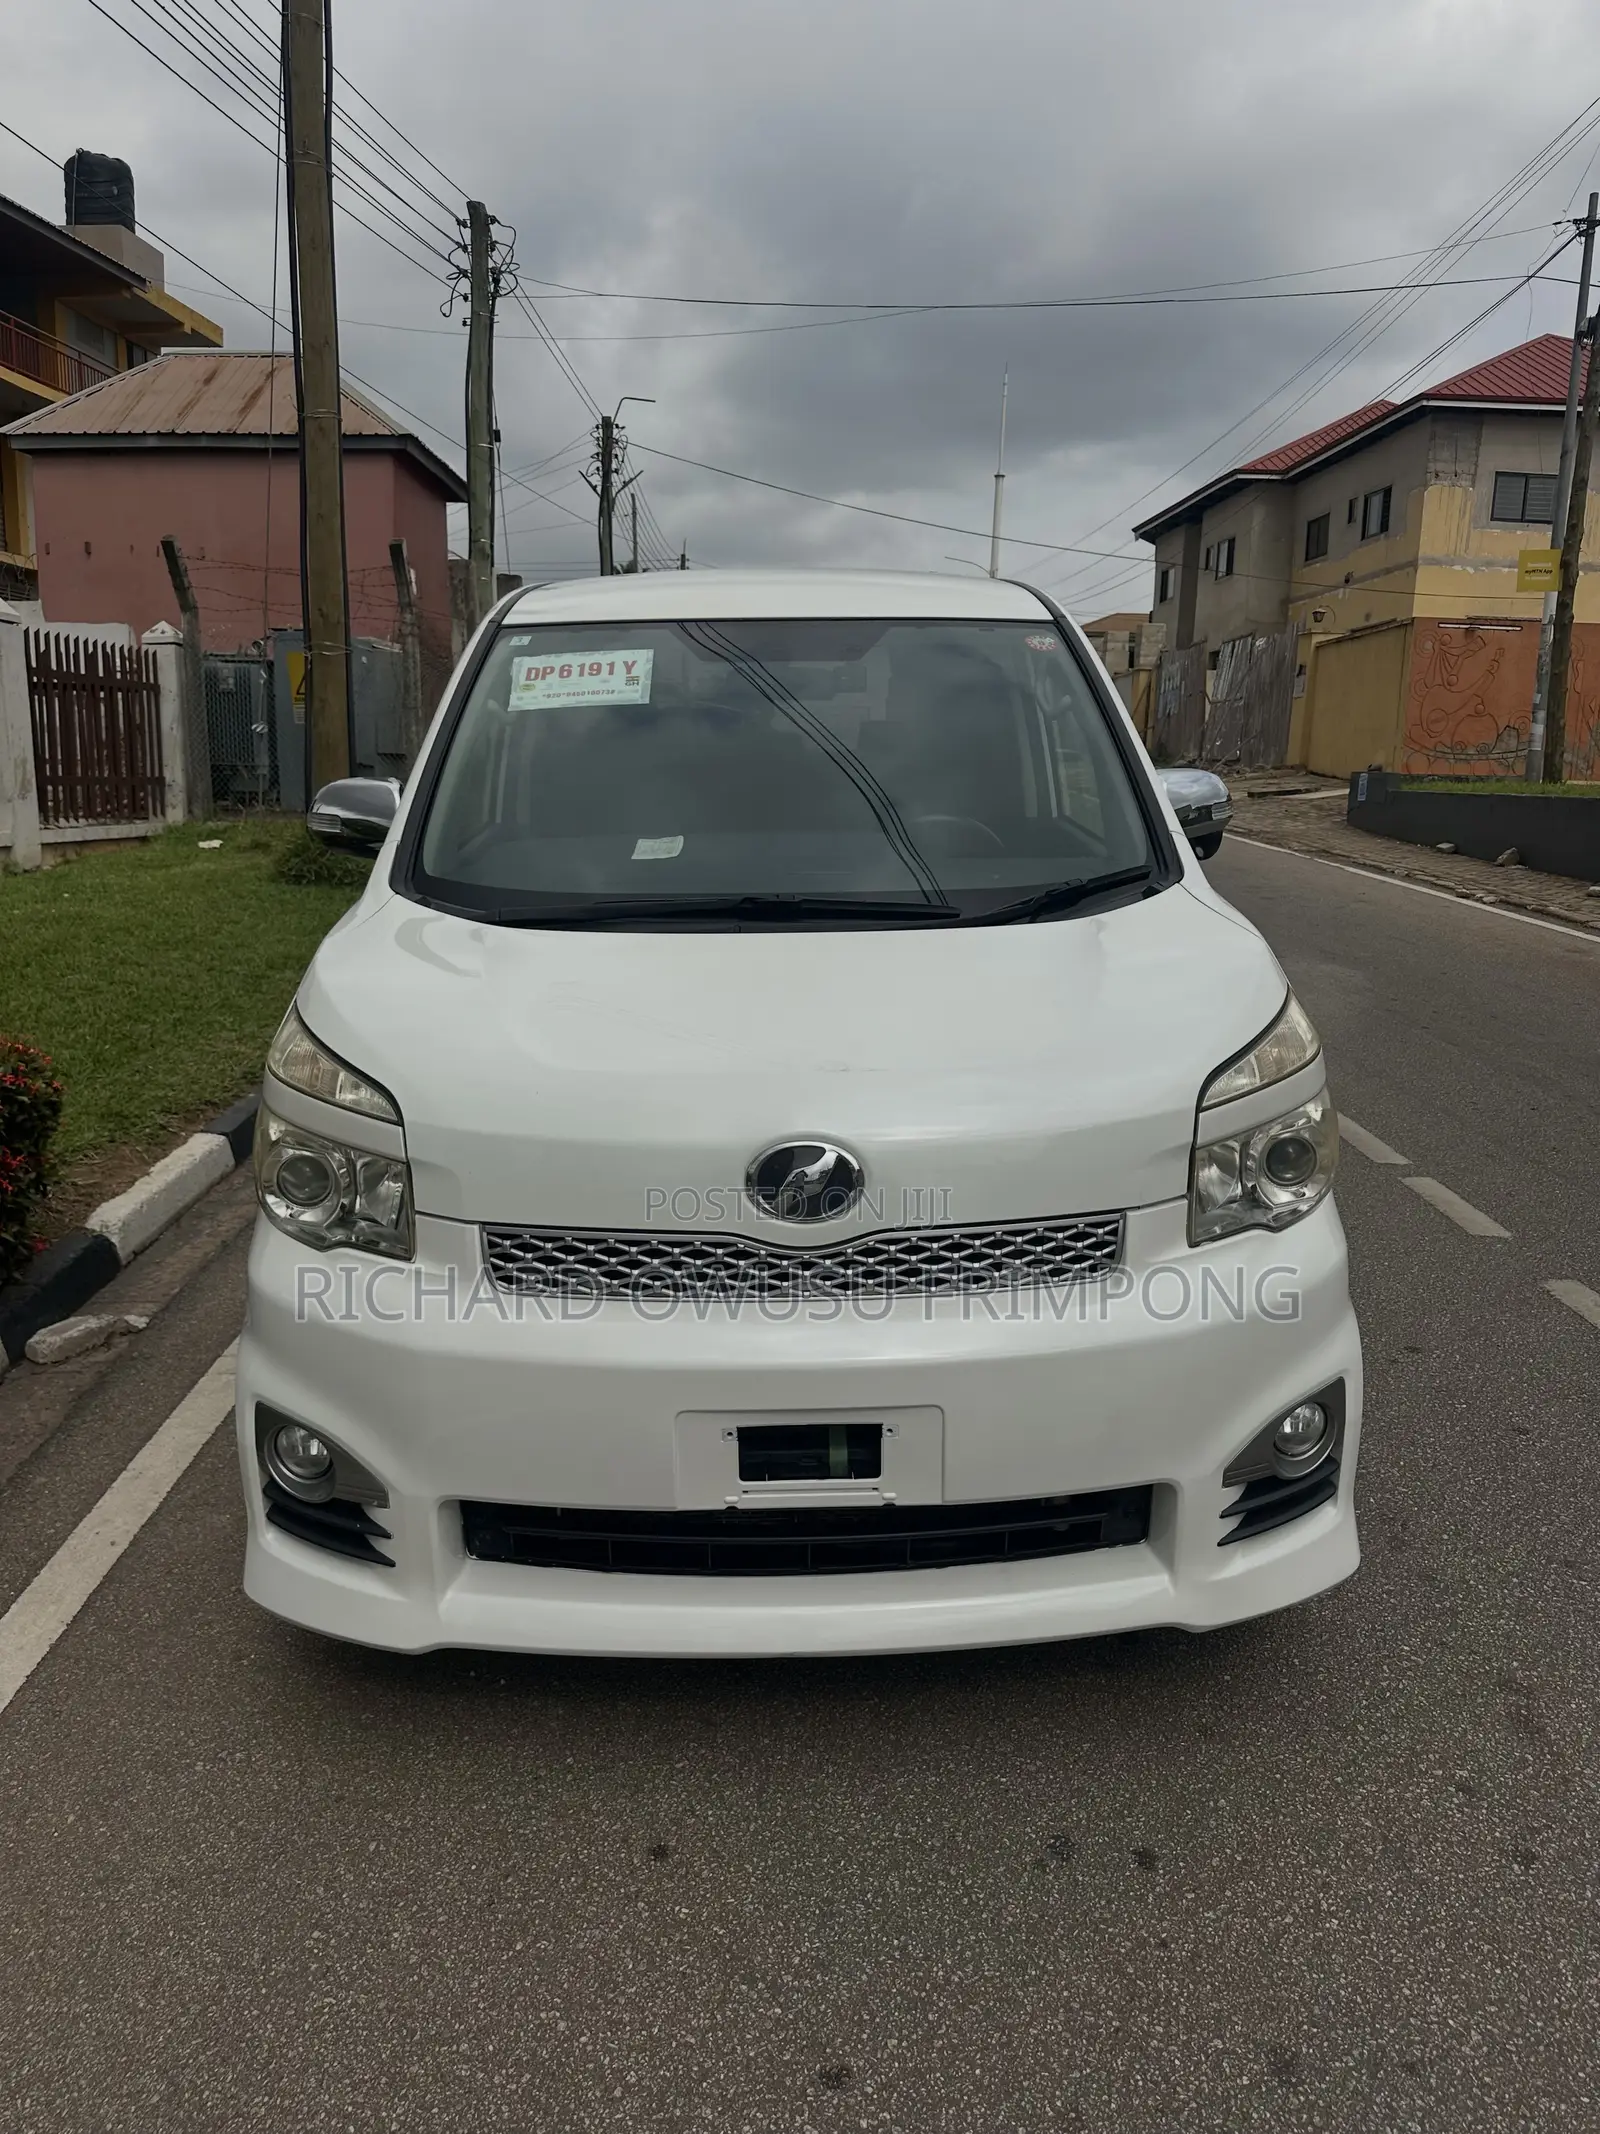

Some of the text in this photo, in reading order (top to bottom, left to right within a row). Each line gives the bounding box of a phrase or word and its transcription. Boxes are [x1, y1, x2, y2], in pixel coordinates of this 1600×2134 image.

[524, 660, 638, 681] DP 6191 Y
